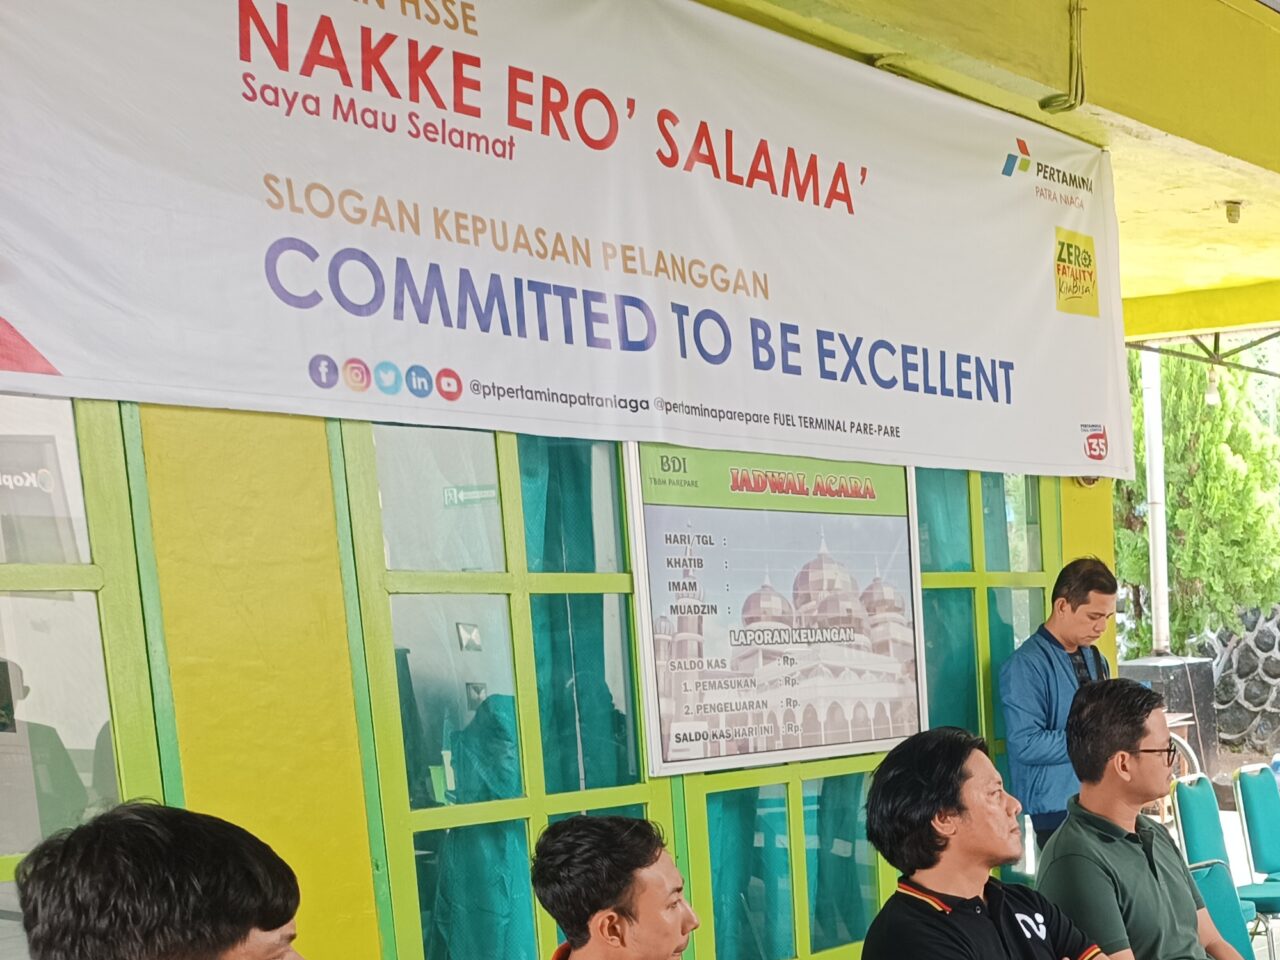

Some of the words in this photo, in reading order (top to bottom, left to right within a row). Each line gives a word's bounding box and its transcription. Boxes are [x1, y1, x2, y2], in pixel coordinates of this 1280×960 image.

[238, 0, 481, 118] NAKKE
[241, 72, 320, 117] Saya
[332, 94, 397, 133] Mau
[407, 111, 516, 160] Selamat
[1036, 162, 1093, 194] PERTAMINA
[1035, 186, 1057, 204] PATRA
[1059, 194, 1085, 210] NIAGA
[263, 173, 420, 236] SLOGAN
[433, 206, 591, 268] KEPUASAN
[602, 241, 769, 300] PELANGGAN
[264, 236, 657, 352] COMMITTED
[670, 302, 732, 366] TO
[749, 317, 802, 376] BE
[816, 329, 1014, 405] EXCELLENT
[469, 379, 650, 413] @ptpertaminapatraniaga
[653, 396, 770, 427] @pertaminaparepare
[774, 412, 797, 428] FUEL
[798, 415, 848, 434] TERMINAL
[849, 421, 901, 439] PARE-PARE
[660, 455, 687, 474] BDI
[730, 467, 809, 497] JADWAL
[812, 474, 876, 500] ACARA
[665, 534, 715, 546] HARI/TGL
[666, 557, 704, 569] KHATIB
[668, 581, 697, 592] IMAM
[669, 604, 718, 615] MUADZIN
[730, 629, 790, 646] LAPORAN
[791, 627, 855, 644] KEUANGAN
[669, 660, 704, 671] SALDO
[706, 658, 727, 669] KAS
[783, 656, 798, 667] Rp.
[683, 682, 692, 693] 1.
[695, 678, 757, 691] PEMASUKAN
[784, 676, 800, 687] Rp.
[684, 705, 693, 715] 2.
[696, 700, 768, 714] PENGELUARAN
[785, 698, 801, 709] Rp.
[675, 731, 709, 743] SALDO
[711, 729, 731, 740] KAS
[734, 726, 758, 738] HARI
[760, 724, 773, 735] INI
[787, 722, 802, 734] Rp.
